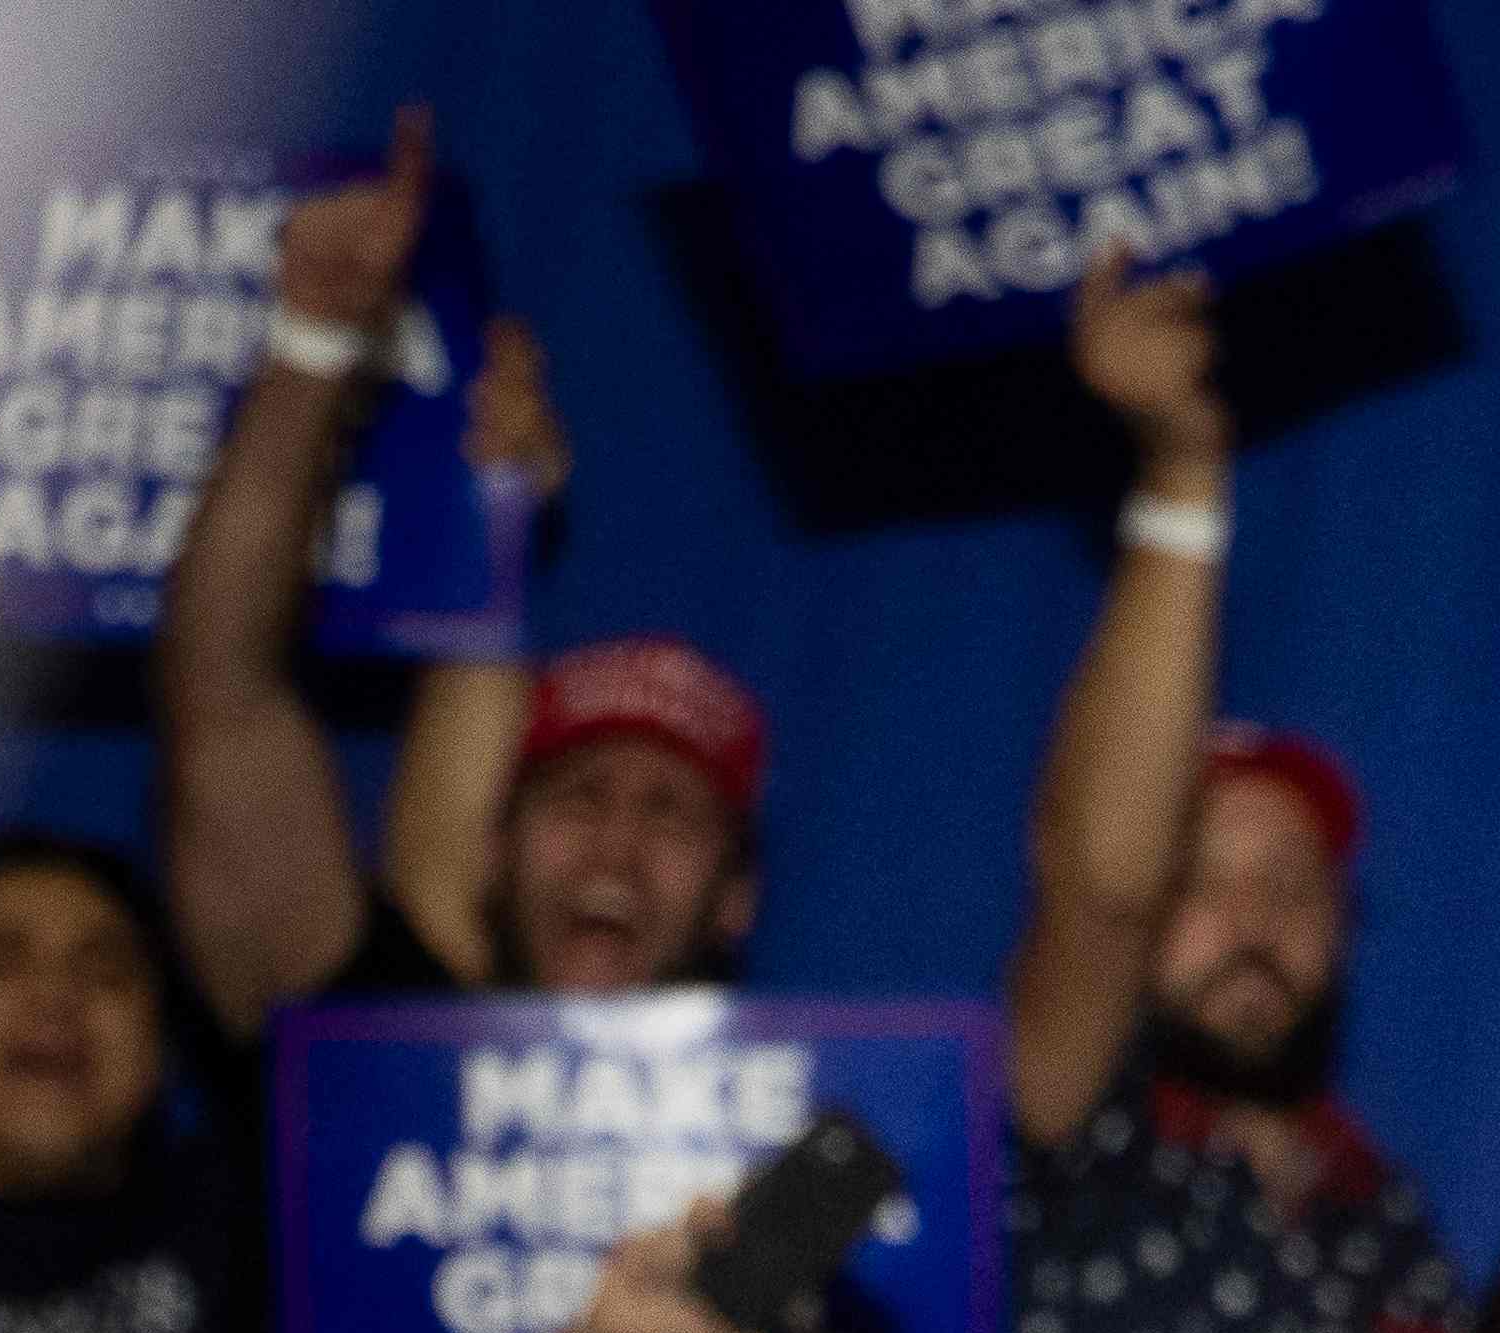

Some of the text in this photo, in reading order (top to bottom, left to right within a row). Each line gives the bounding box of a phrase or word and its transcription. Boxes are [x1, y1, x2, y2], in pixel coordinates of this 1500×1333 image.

[878, 47, 1271, 221] GREAT
[40, 183, 288, 276] MAK
[460, 1045, 812, 1150] MAKE
